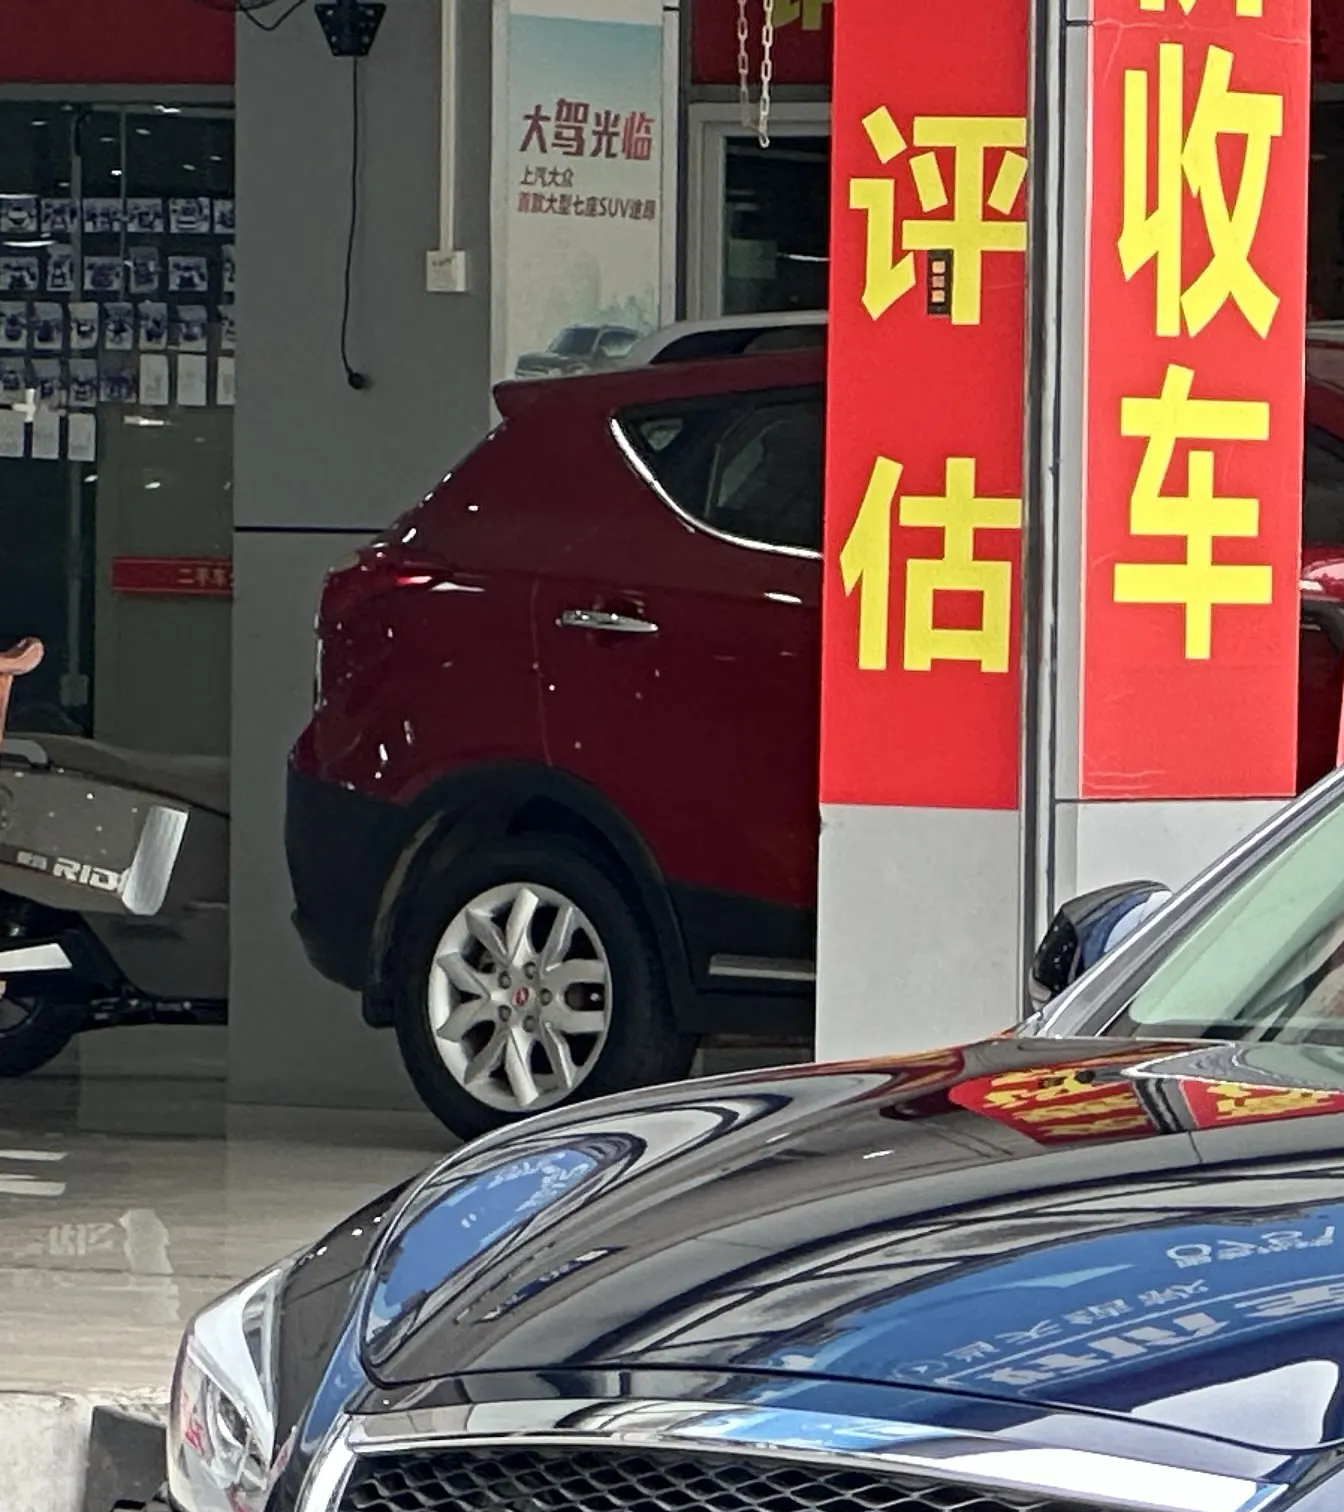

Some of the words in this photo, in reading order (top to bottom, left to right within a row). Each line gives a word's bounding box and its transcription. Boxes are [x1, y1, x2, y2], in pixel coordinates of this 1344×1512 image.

[519, 98, 655, 160] 大驾光临
[520, 165, 574, 187] 上汽大众
[839, 105, 1027, 672] 评估
[1114, 0, 1283, 660] 收车
